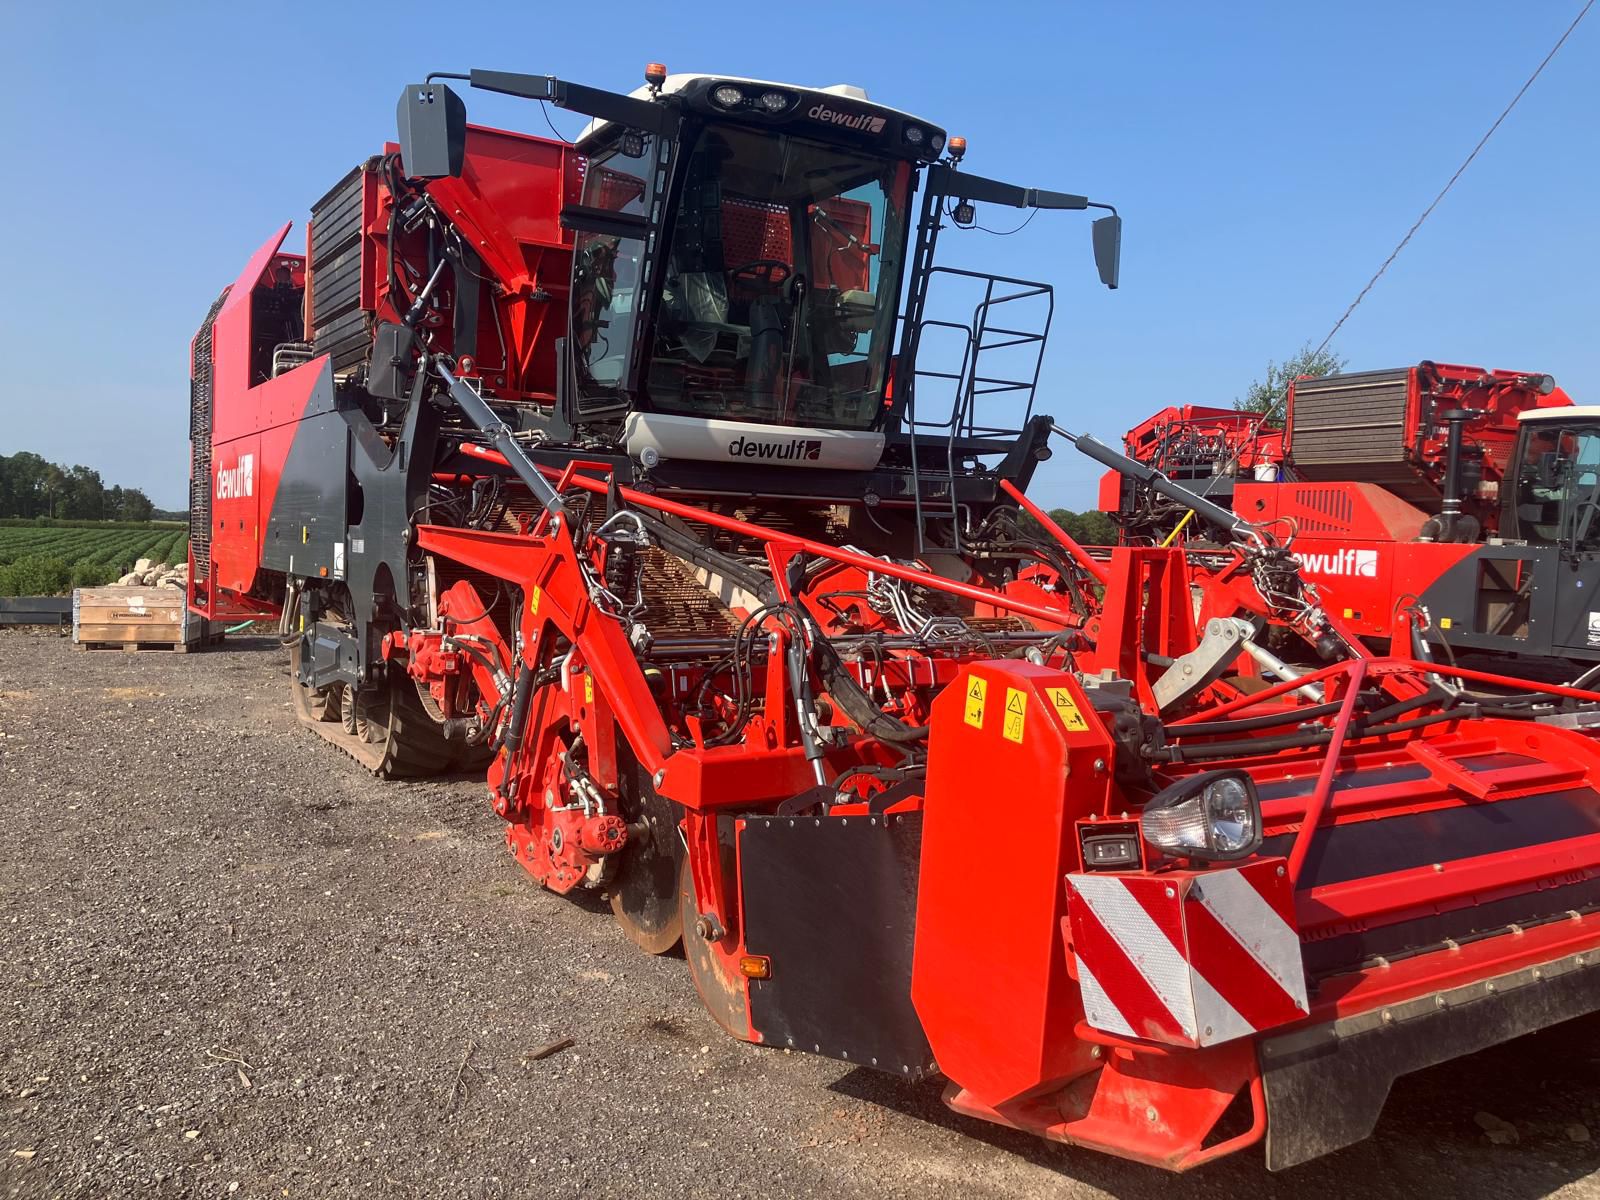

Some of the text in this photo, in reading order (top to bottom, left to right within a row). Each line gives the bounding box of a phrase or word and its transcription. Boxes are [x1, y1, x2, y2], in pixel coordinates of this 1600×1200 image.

[808, 103, 872, 132] dewulf
[728, 436, 806, 460] dewulf
[216, 455, 245, 500] dewulf
